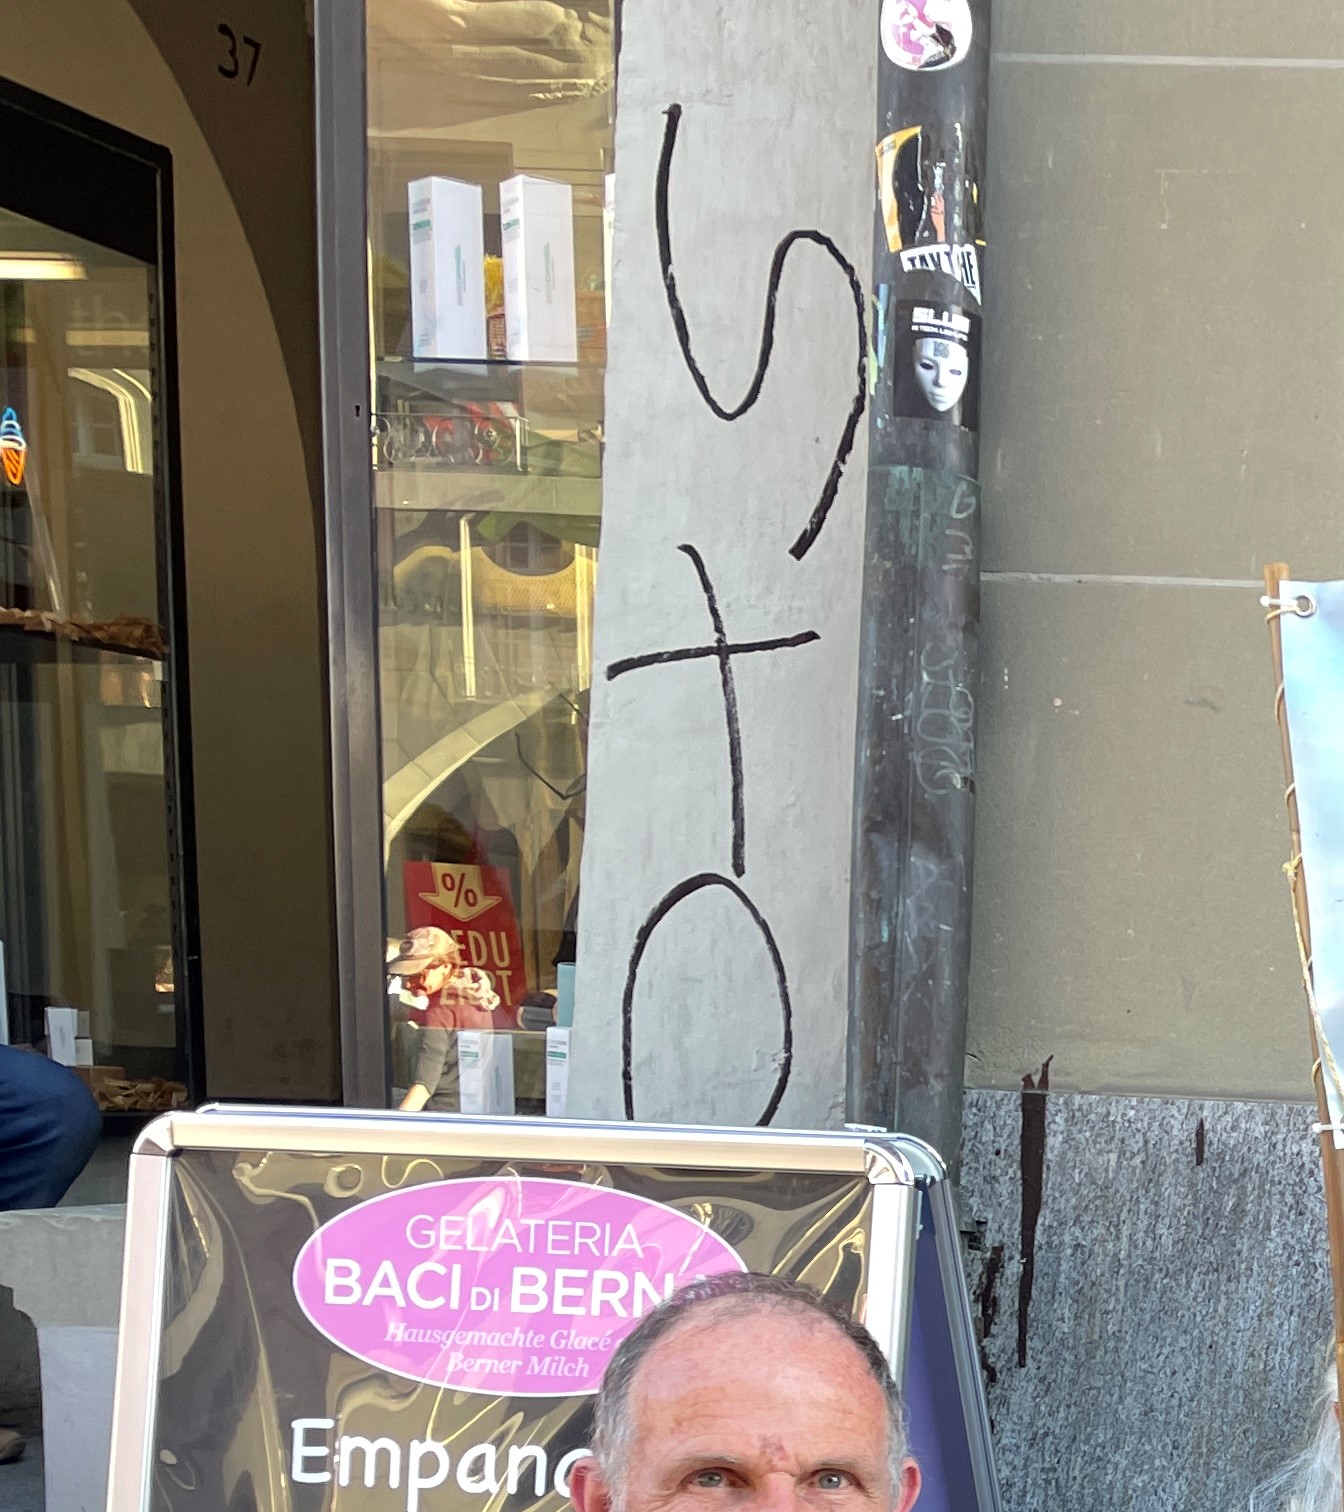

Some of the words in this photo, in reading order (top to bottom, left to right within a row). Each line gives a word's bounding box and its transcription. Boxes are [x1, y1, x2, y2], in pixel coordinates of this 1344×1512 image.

[218, 23, 262, 88] 37
[405, 1213, 644, 1259] GELATERIA
[324, 1257, 462, 1311] BACI
[470, 1286, 500, 1312] DI
[510, 1266, 675, 1318] BERN
[383, 1319, 546, 1351] Hausgemachte
[549, 1326, 612, 1351] Glacé
[444, 1352, 522, 1376] Berner
[524, 1354, 590, 1378] Milch
